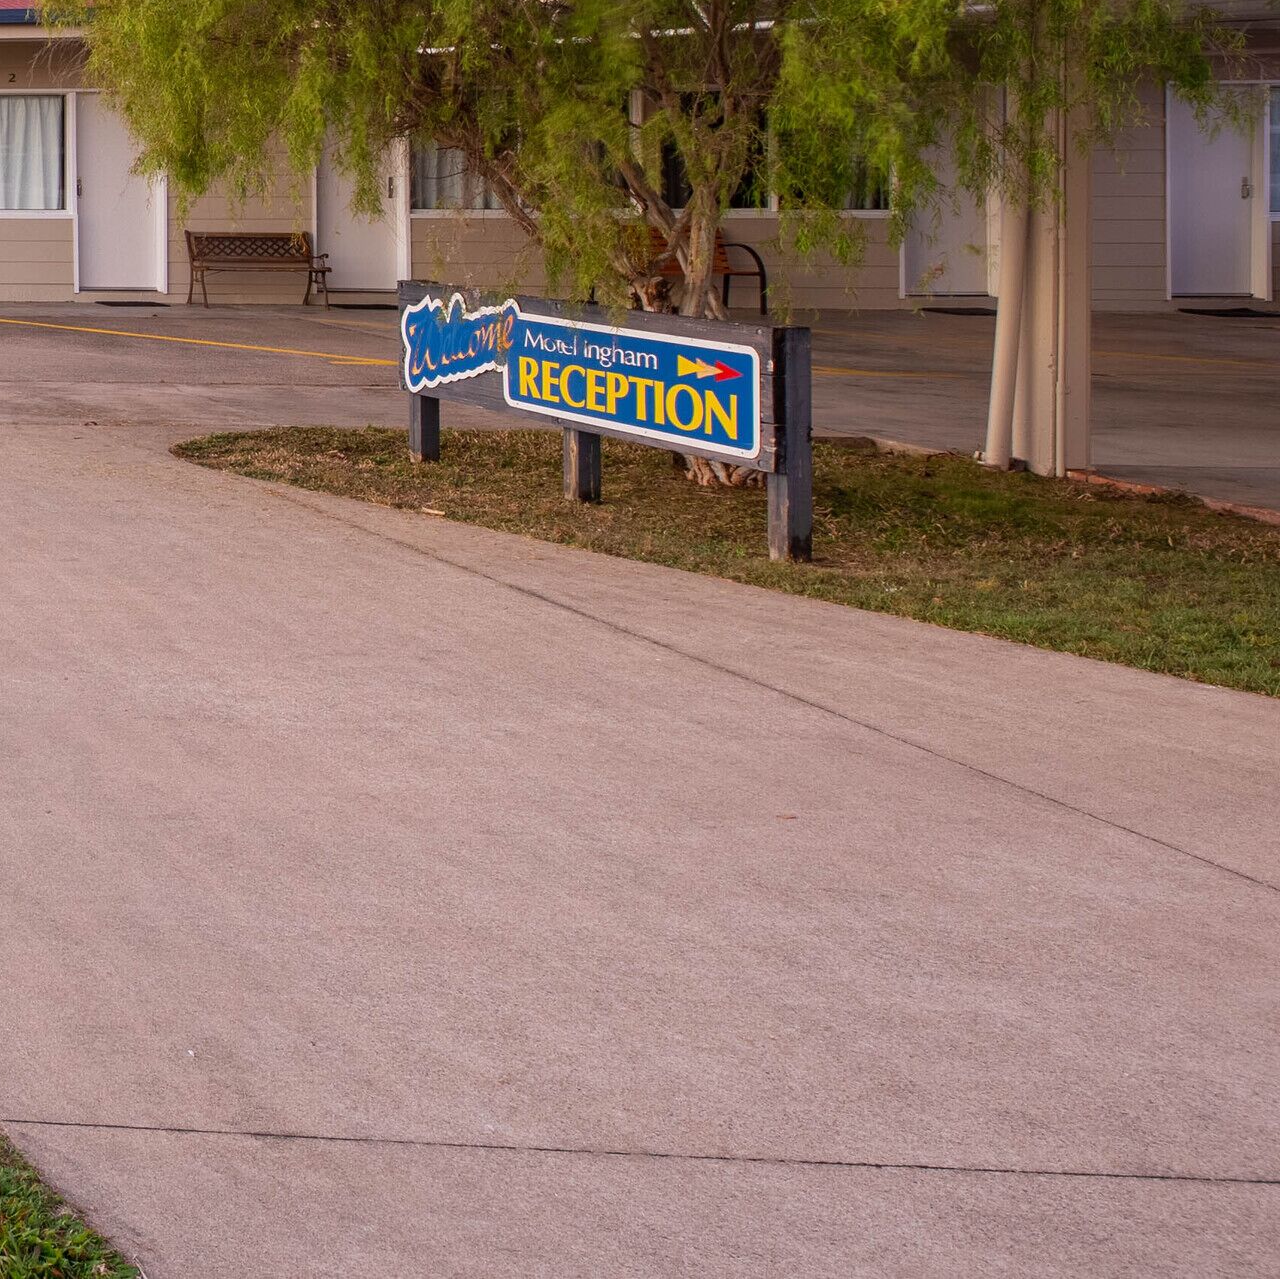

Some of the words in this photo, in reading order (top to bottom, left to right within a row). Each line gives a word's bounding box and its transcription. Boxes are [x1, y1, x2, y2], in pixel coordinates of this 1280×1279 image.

[9, 73, 16, 82] 2
[523, 328, 577, 356] Motel
[518, 355, 738, 441] RECEPTION
